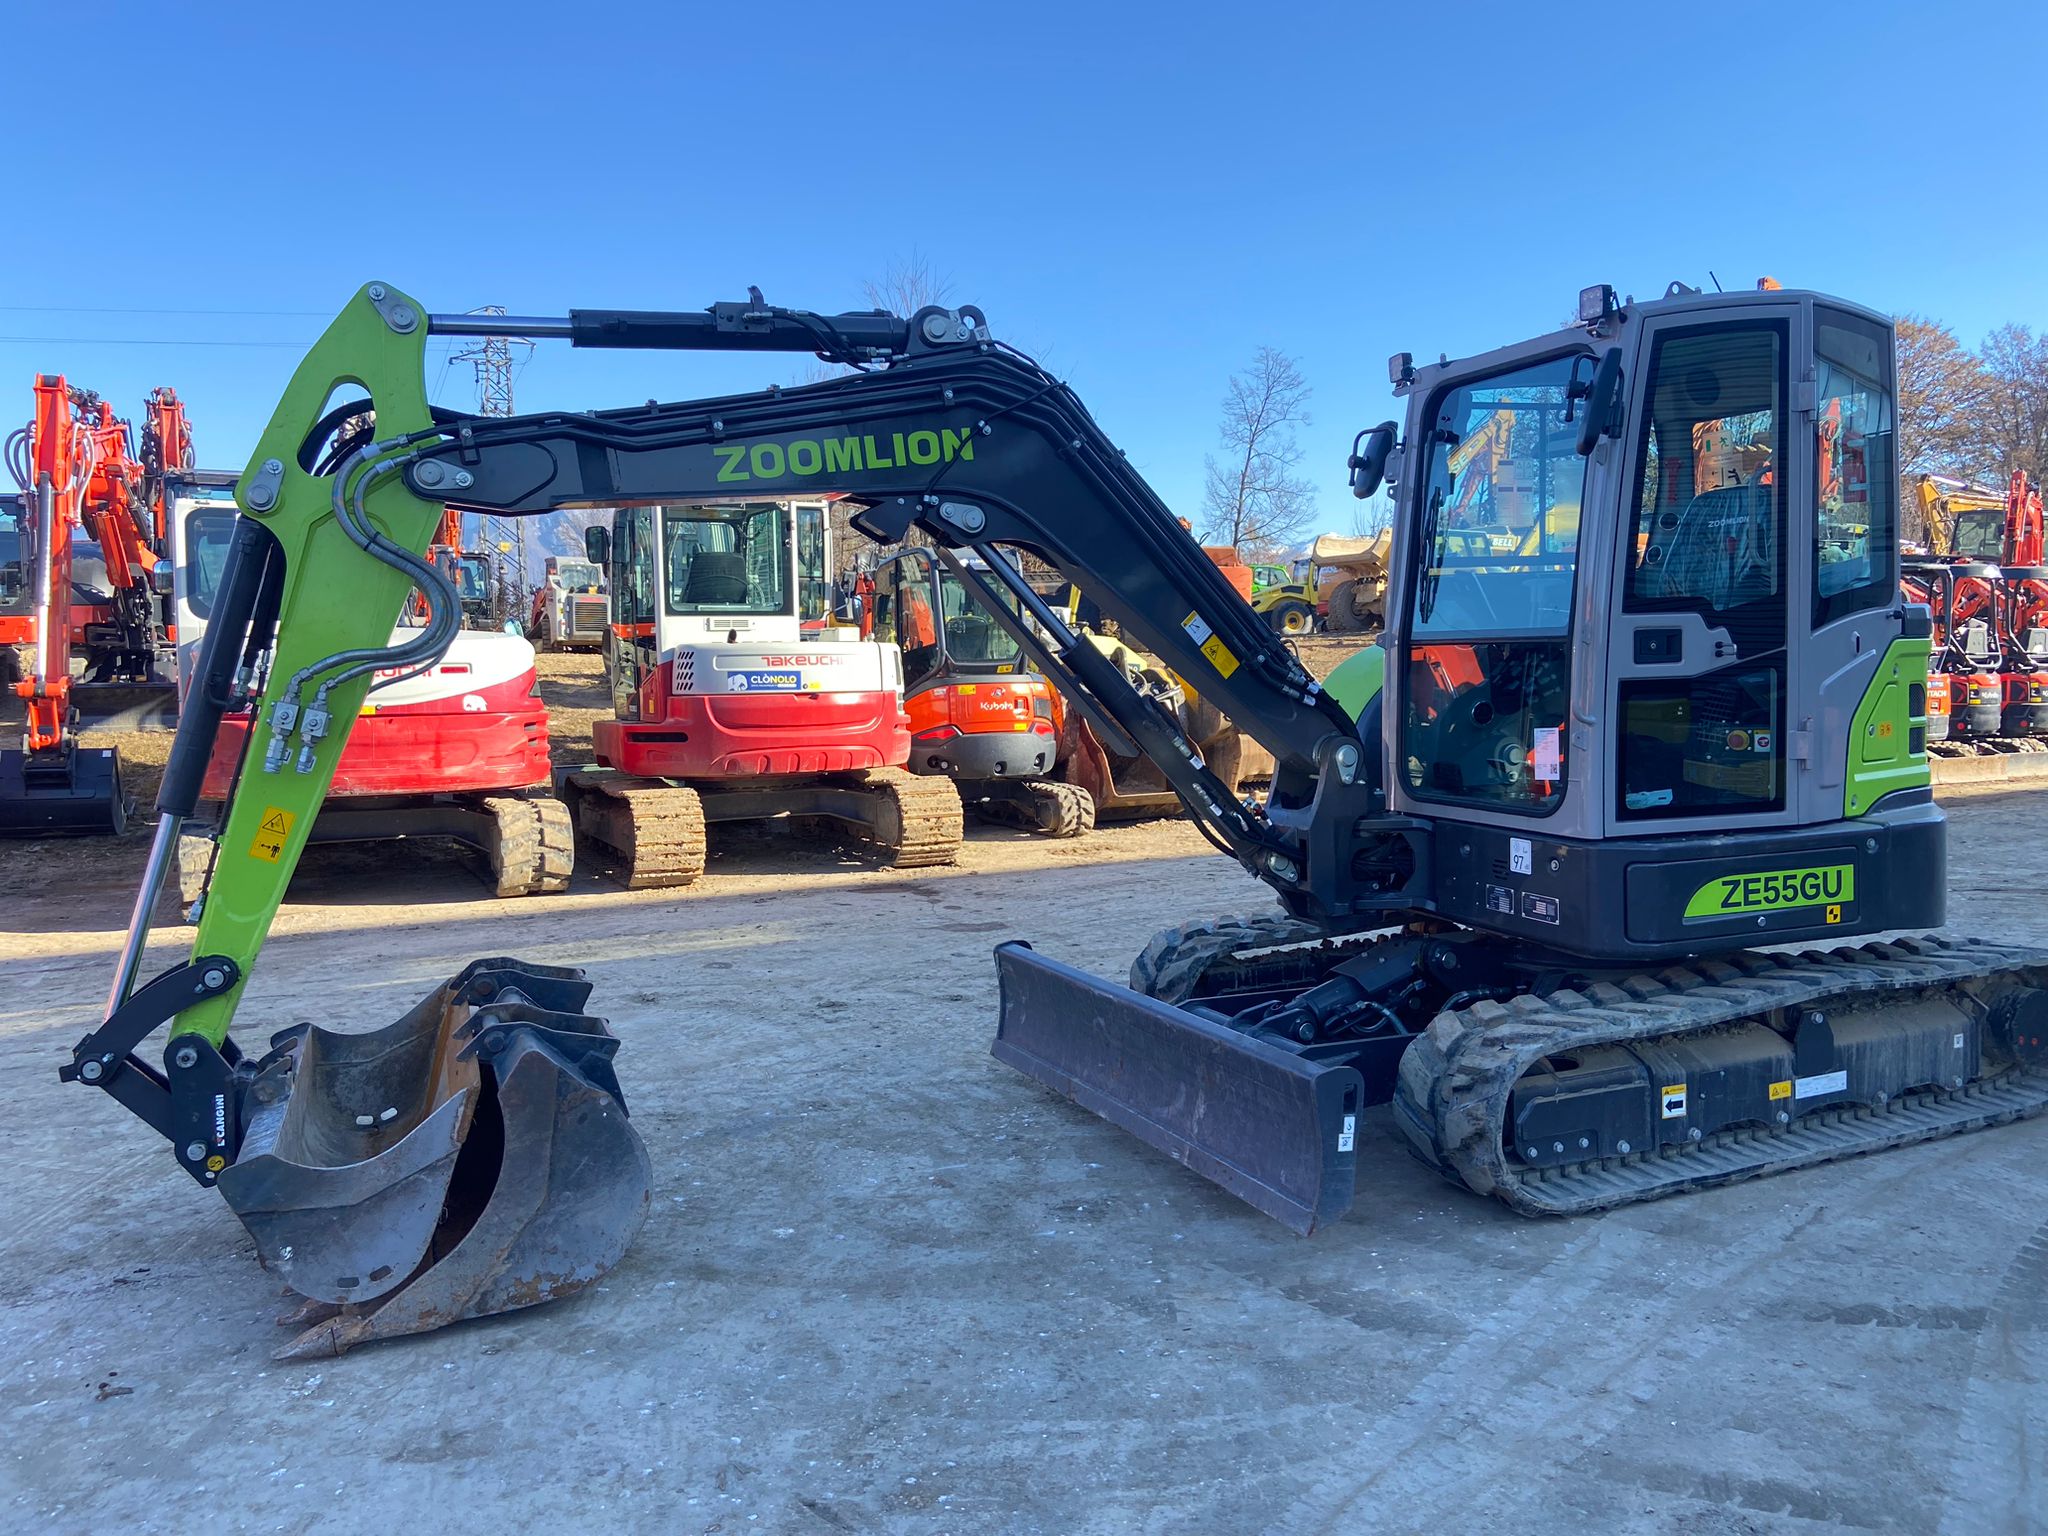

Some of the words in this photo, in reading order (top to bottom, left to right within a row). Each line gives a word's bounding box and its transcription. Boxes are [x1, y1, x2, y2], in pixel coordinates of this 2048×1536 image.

[713, 427, 974, 482] ZOOMLION
[1493, 537, 1513, 547] BELL
[761, 656, 843, 667] TAKEUCHI
[751, 674, 797, 684] CLÒNOLO
[980, 702, 1013, 711] Kubota
[1513, 854, 1524, 870] 97
[1720, 869, 1842, 909] ZE55GU
[215, 1093, 226, 1138] CANGINI
